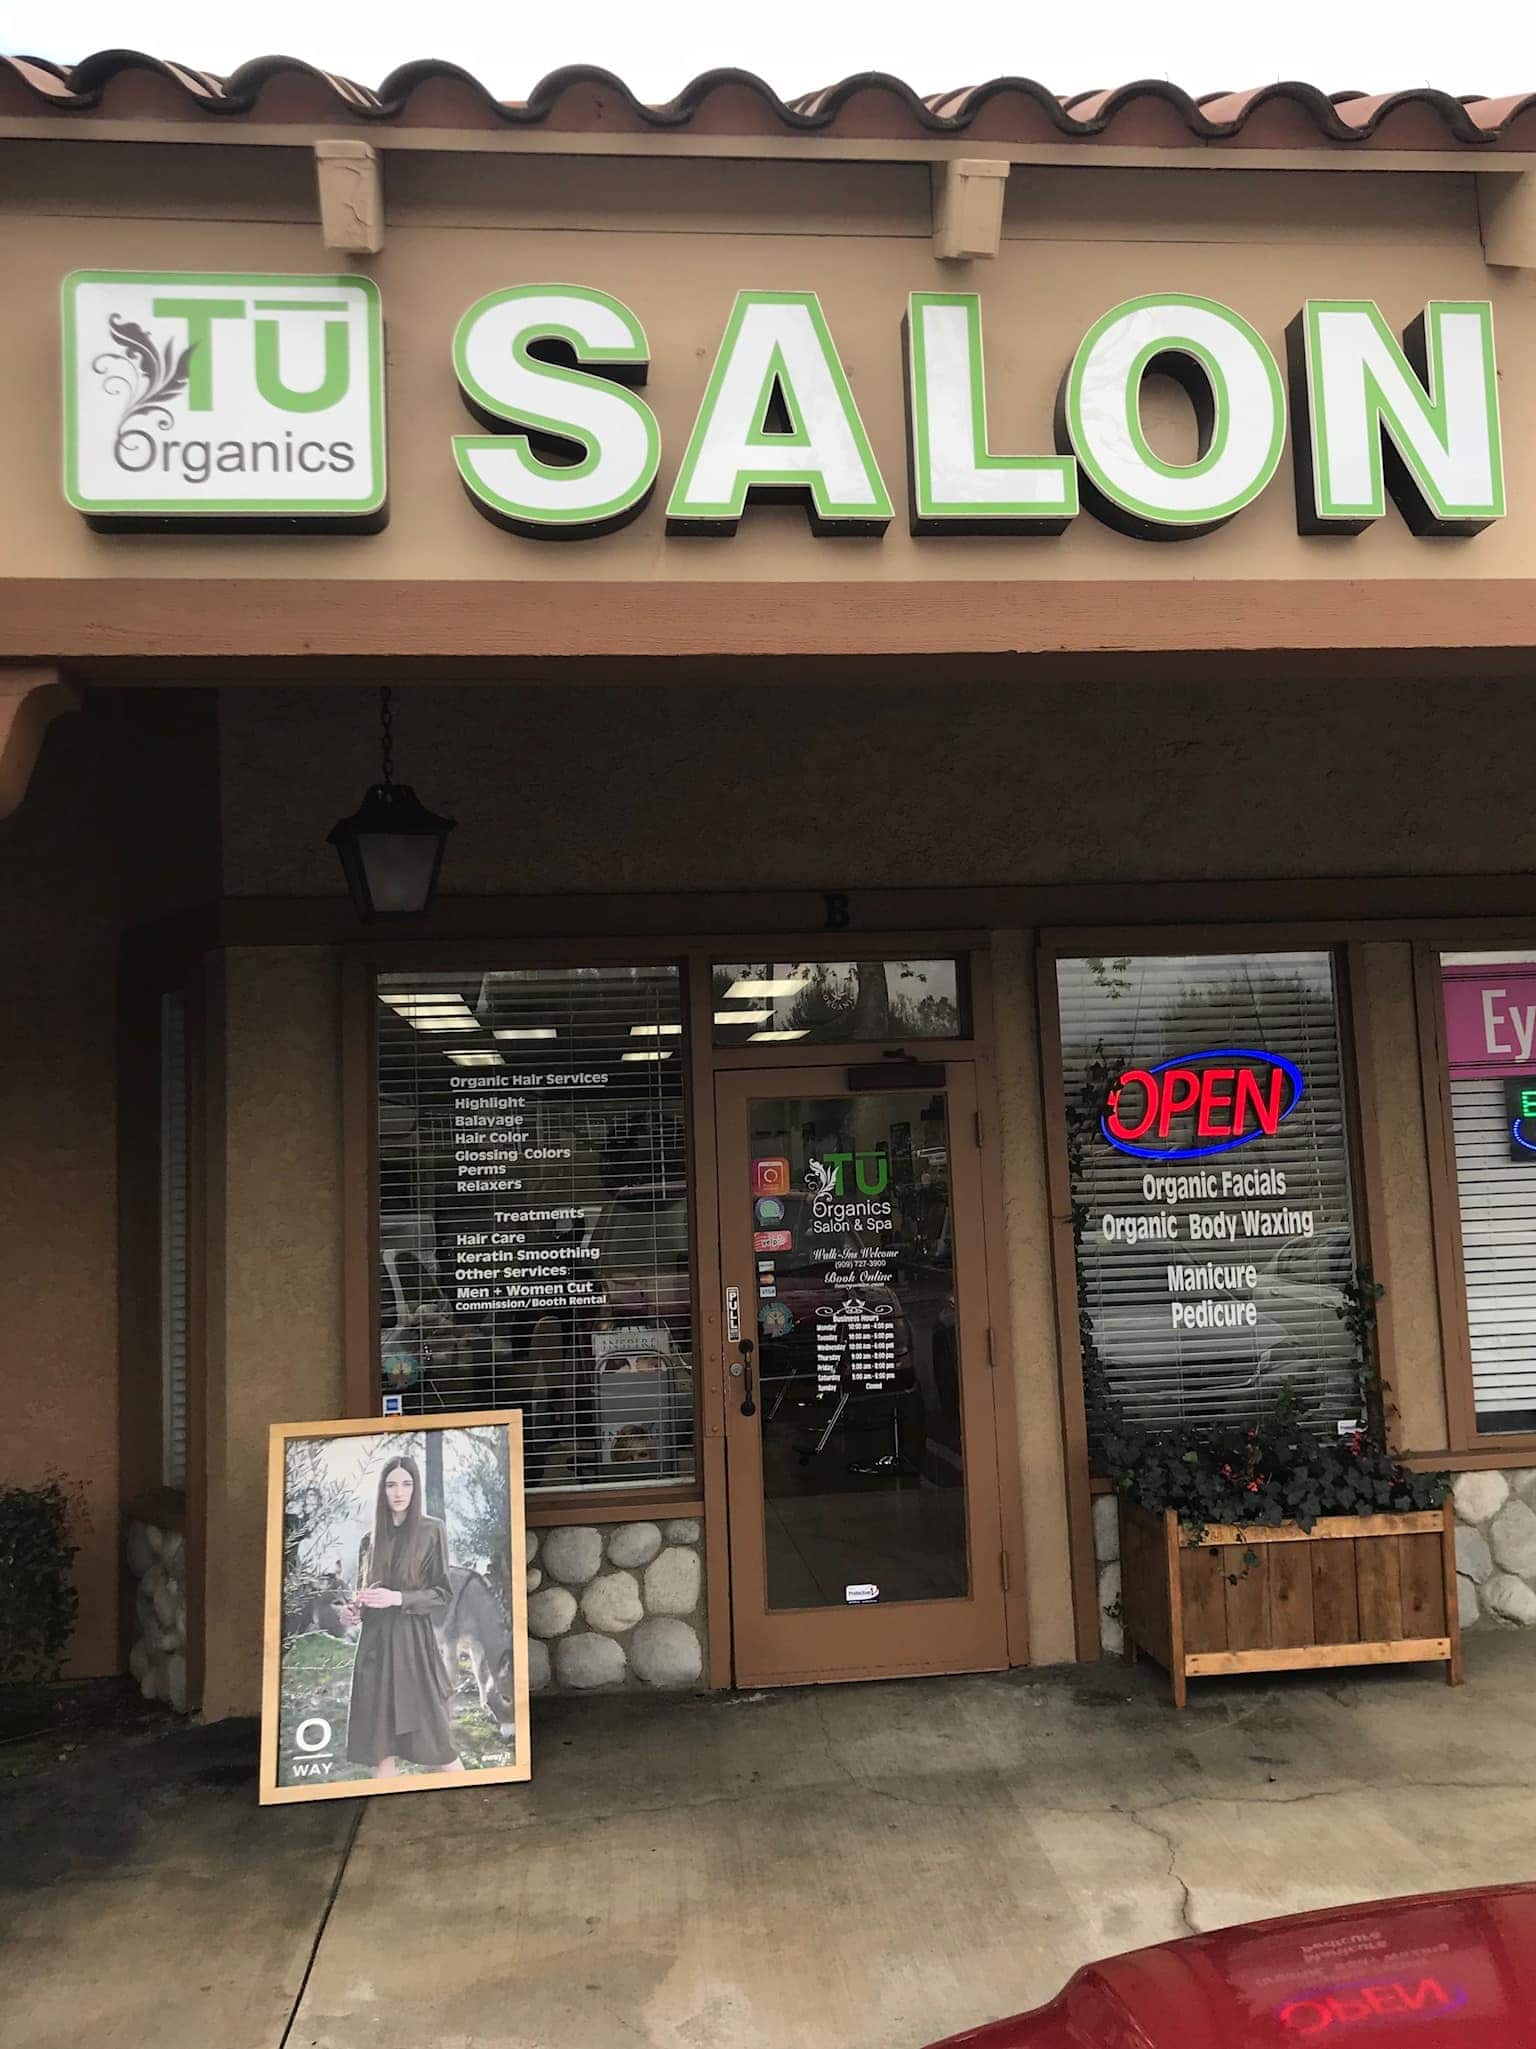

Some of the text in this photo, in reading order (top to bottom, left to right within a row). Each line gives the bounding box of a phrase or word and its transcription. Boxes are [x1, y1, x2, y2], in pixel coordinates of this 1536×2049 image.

[452, 283, 1506, 530] SALON
[114, 428, 356, 483] Organics
[450, 1072, 609, 1089] Organic Hair Services
[455, 1096, 526, 1110] Highlight
[1107, 1068, 1283, 1140] OPEN
[455, 1115, 523, 1128] Balayage
[455, 1131, 529, 1144] Hair Color
[455, 1147, 571, 1163] Glossing Colors
[458, 1165, 506, 1176] Perms
[457, 1179, 522, 1192] Relaxers
[1143, 1168, 1287, 1204] Organic Facials
[494, 1208, 585, 1223] Treatments
[813, 1199, 892, 1222] Organics
[813, 1217, 892, 1234] Salon & Spa
[1102, 1207, 1314, 1244] Organic Body Waxing
[457, 1232, 525, 1245] Hair Care
[457, 1247, 600, 1264] Keratin Smoothing
[860, 1247, 899, 1259] Welcome
[455, 1268, 500, 1280] Other
[824, 1270, 893, 1283] Book Online
[1168, 1262, 1257, 1291] Manicure
[457, 1281, 593, 1298] Men + Women Cut
[455, 1295, 607, 1311] Commission/Booth Rental
[729, 1292, 738, 1329] PULL
[1172, 1300, 1257, 1328] Pedicure
[296, 1718, 331, 1751] O
[292, 1762, 333, 1777] WAY
